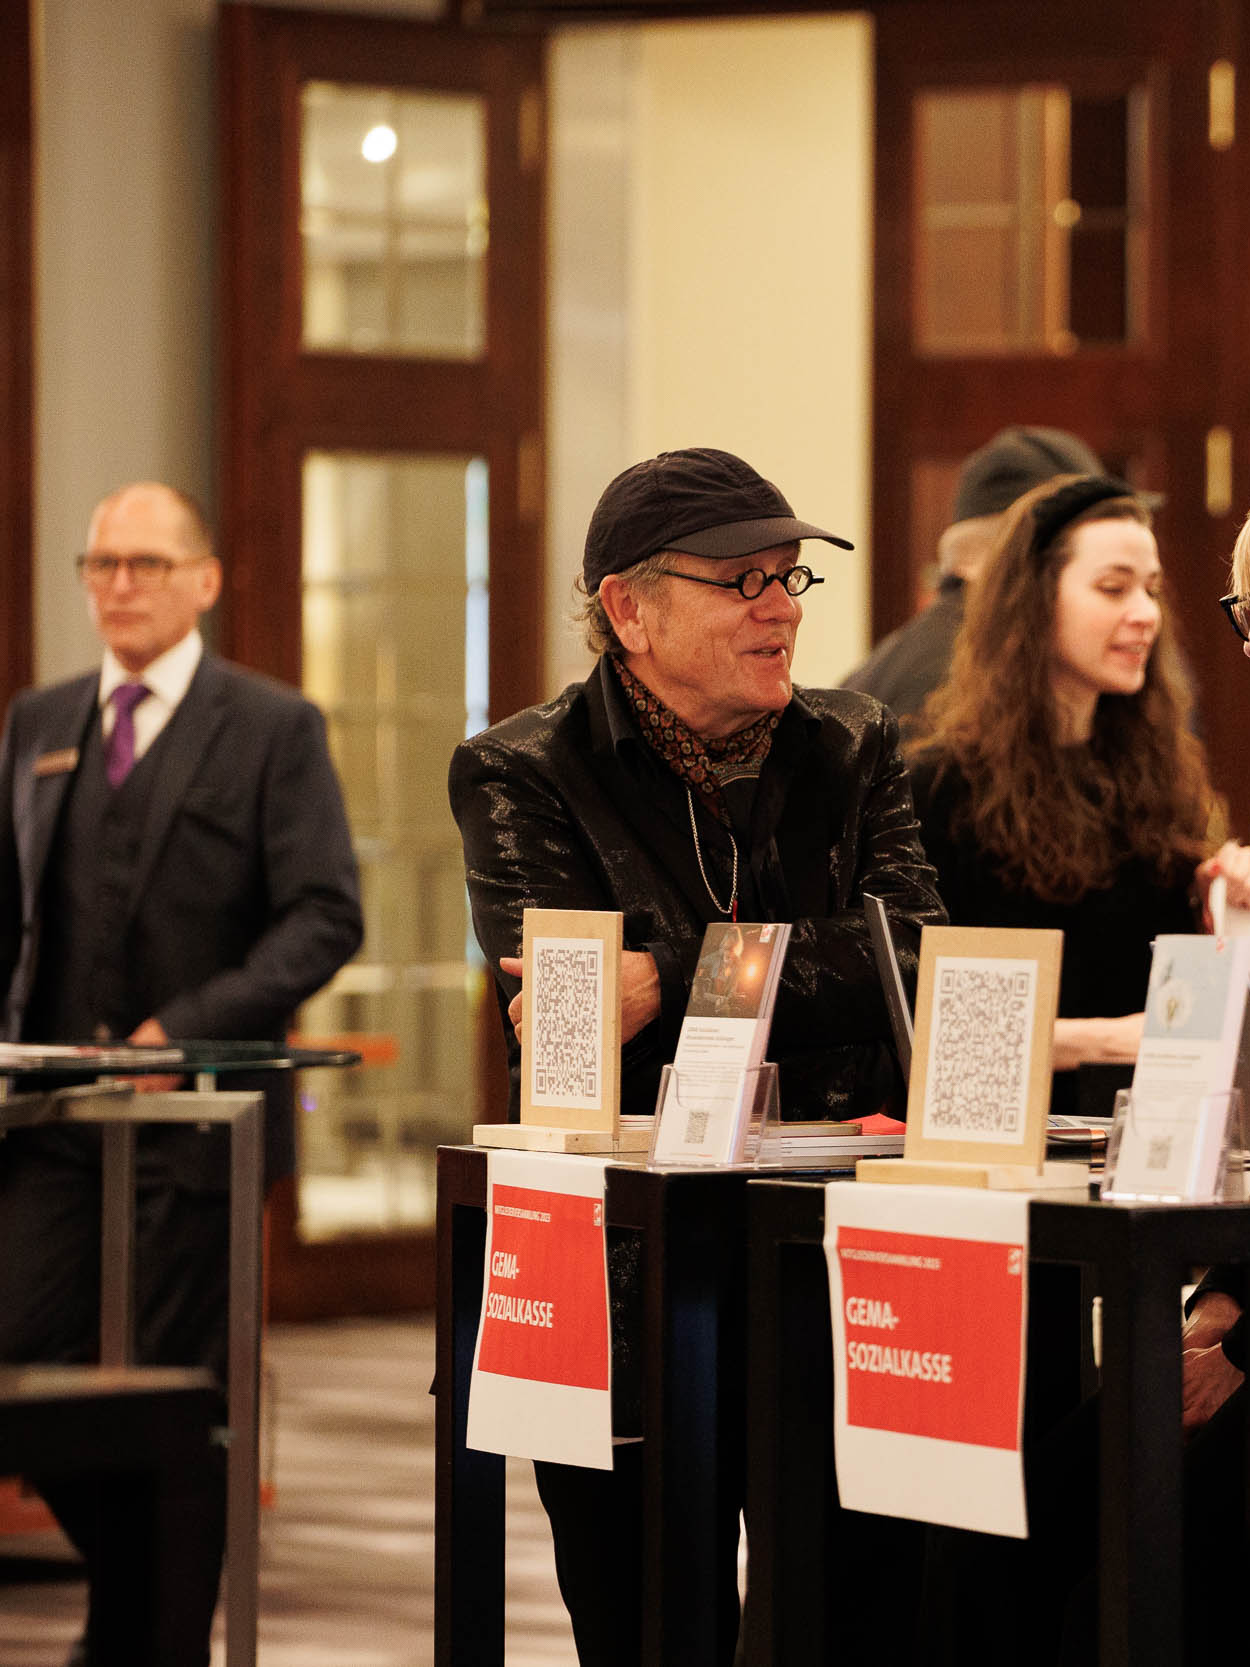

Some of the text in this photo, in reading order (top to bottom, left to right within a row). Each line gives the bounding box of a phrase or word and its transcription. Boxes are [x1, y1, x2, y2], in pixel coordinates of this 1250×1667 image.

[491, 1250, 520, 1280] GEMA-
[486, 1292, 554, 1328] SOZIALKASSE
[845, 1296, 900, 1330] GEMA-
[847, 1340, 953, 1384] SOZIALKASSE
